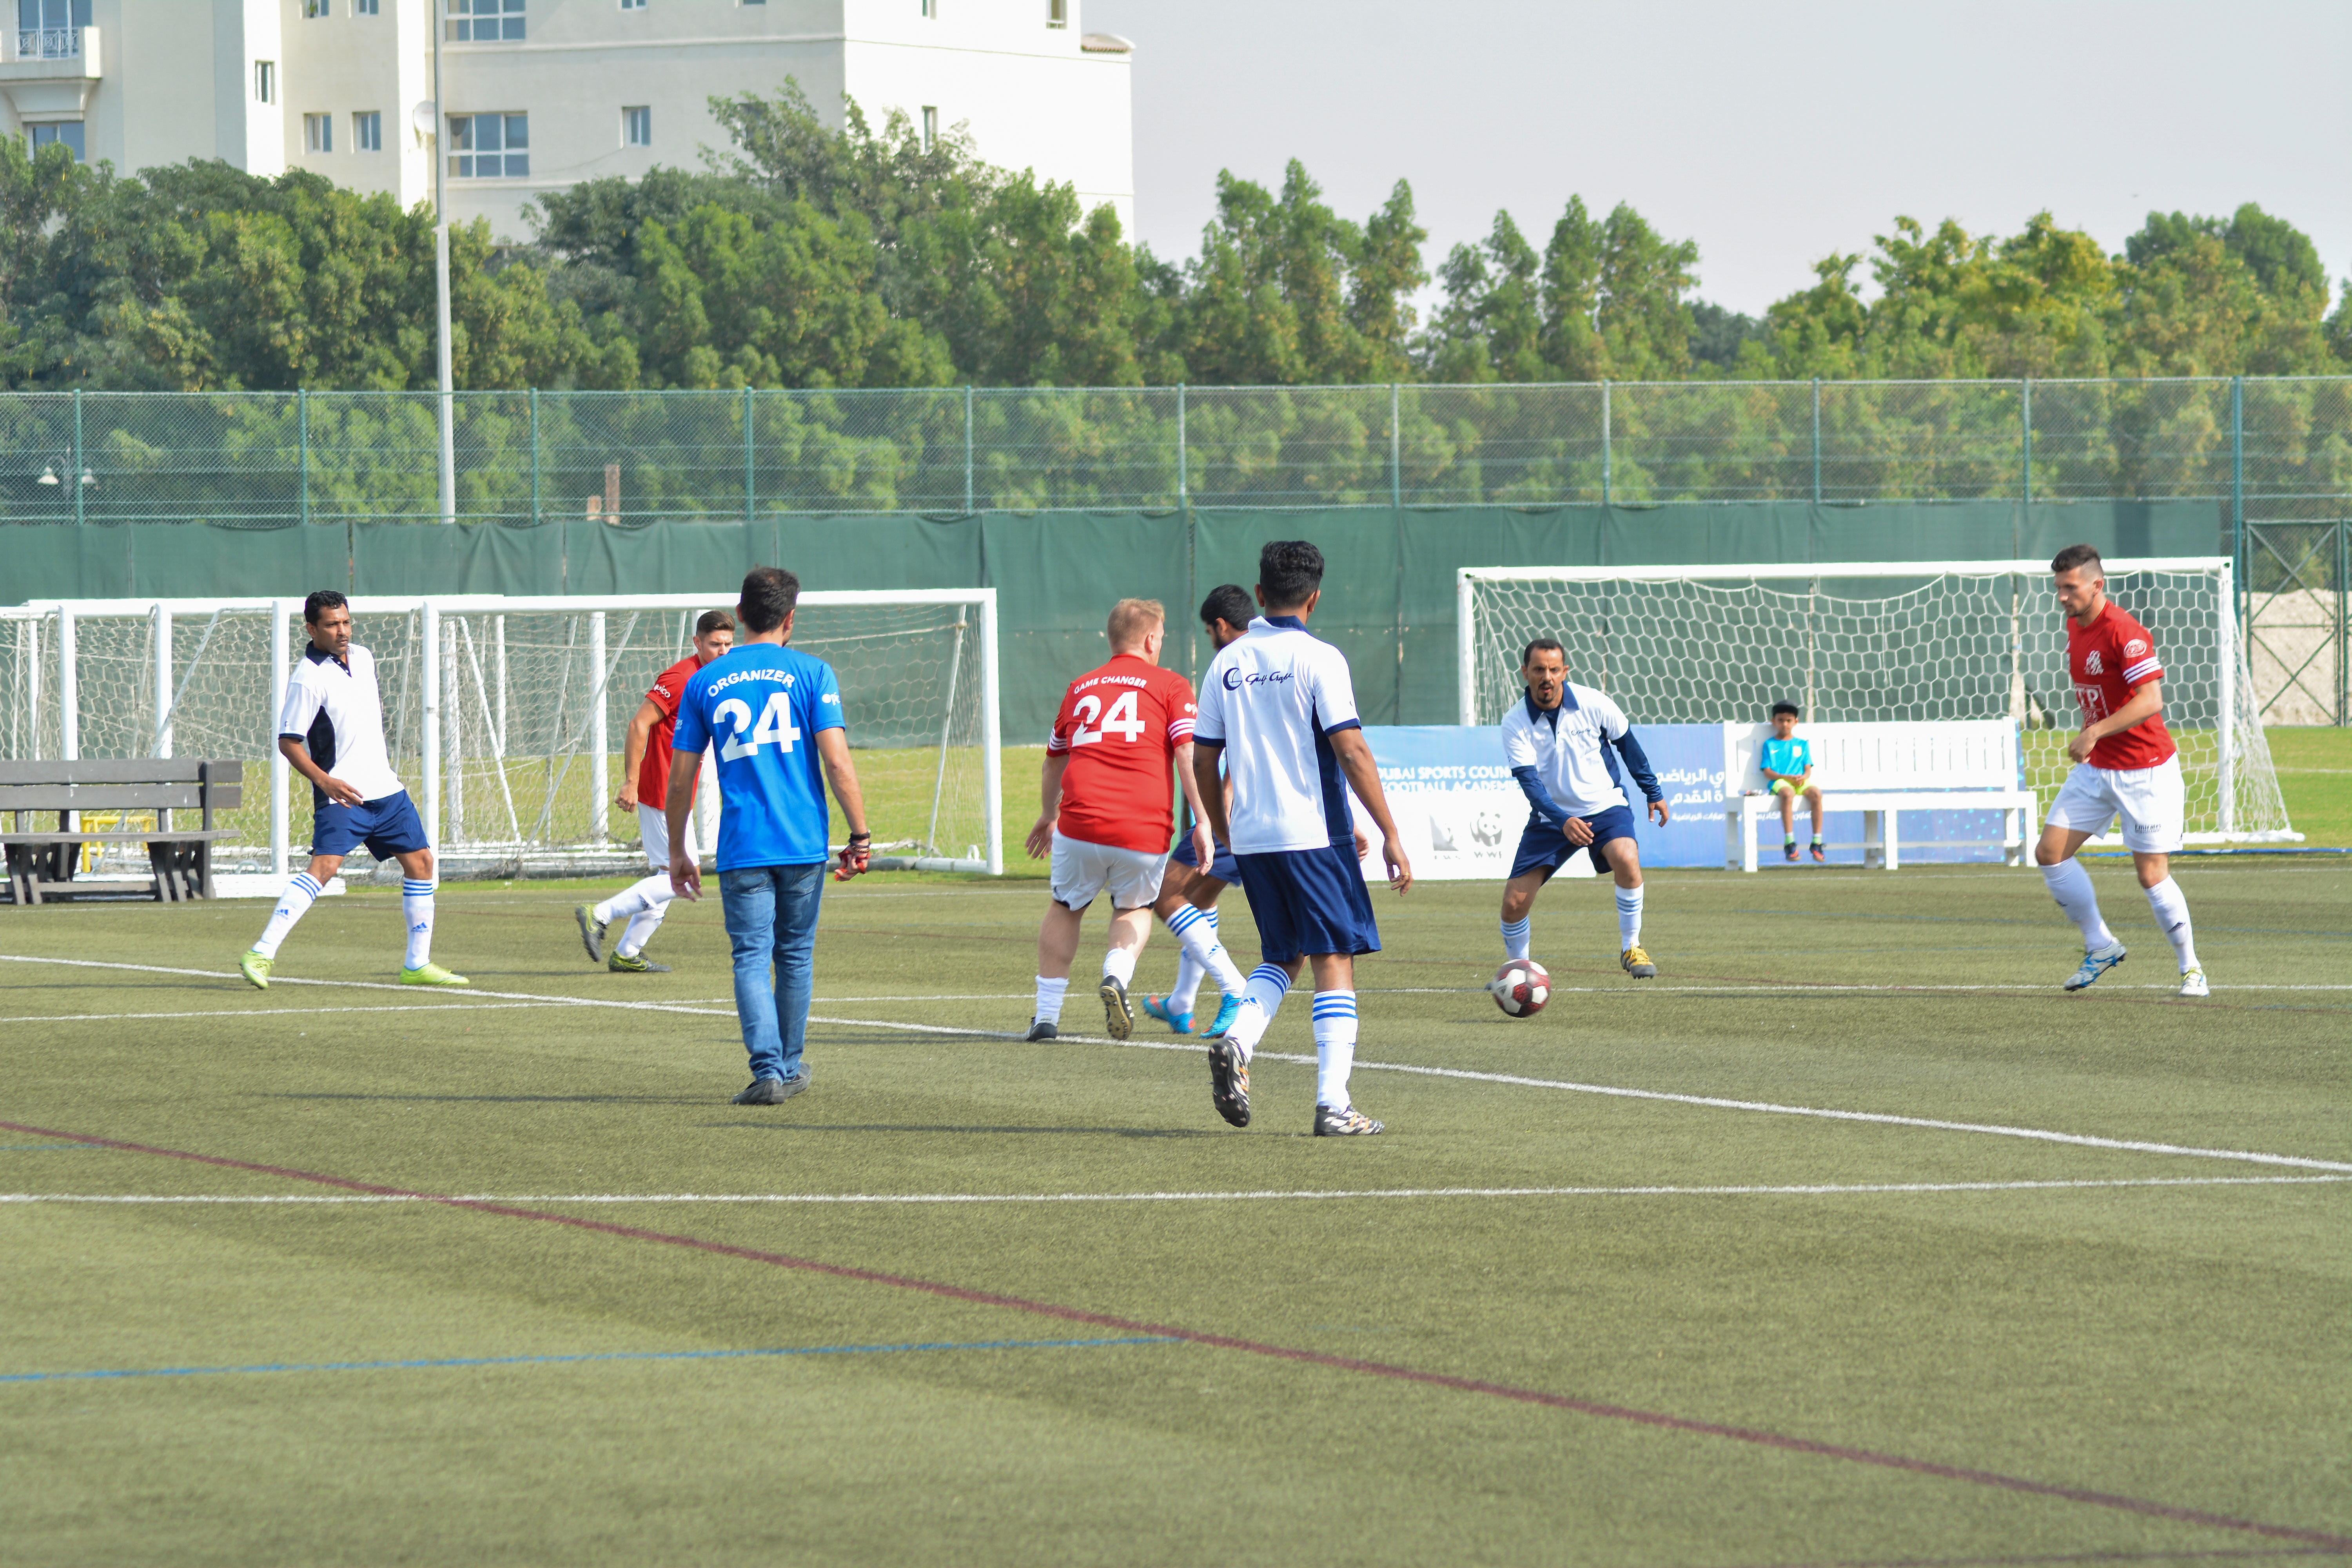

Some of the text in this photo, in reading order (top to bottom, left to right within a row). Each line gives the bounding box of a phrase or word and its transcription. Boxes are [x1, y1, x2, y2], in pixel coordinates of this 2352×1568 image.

[708, 669, 795, 697] ORGANIZER
[1074, 676, 1147, 694] GAME CHANGER
[713, 691, 801, 763] 24
[1072, 691, 1146, 748] 24
[1417, 766, 1466, 779] SPORTS
[1468, 766, 1512, 779] COUN
[1382, 781, 1448, 793] FOOTBALL
[1670, 789, 1712, 806] القدم
